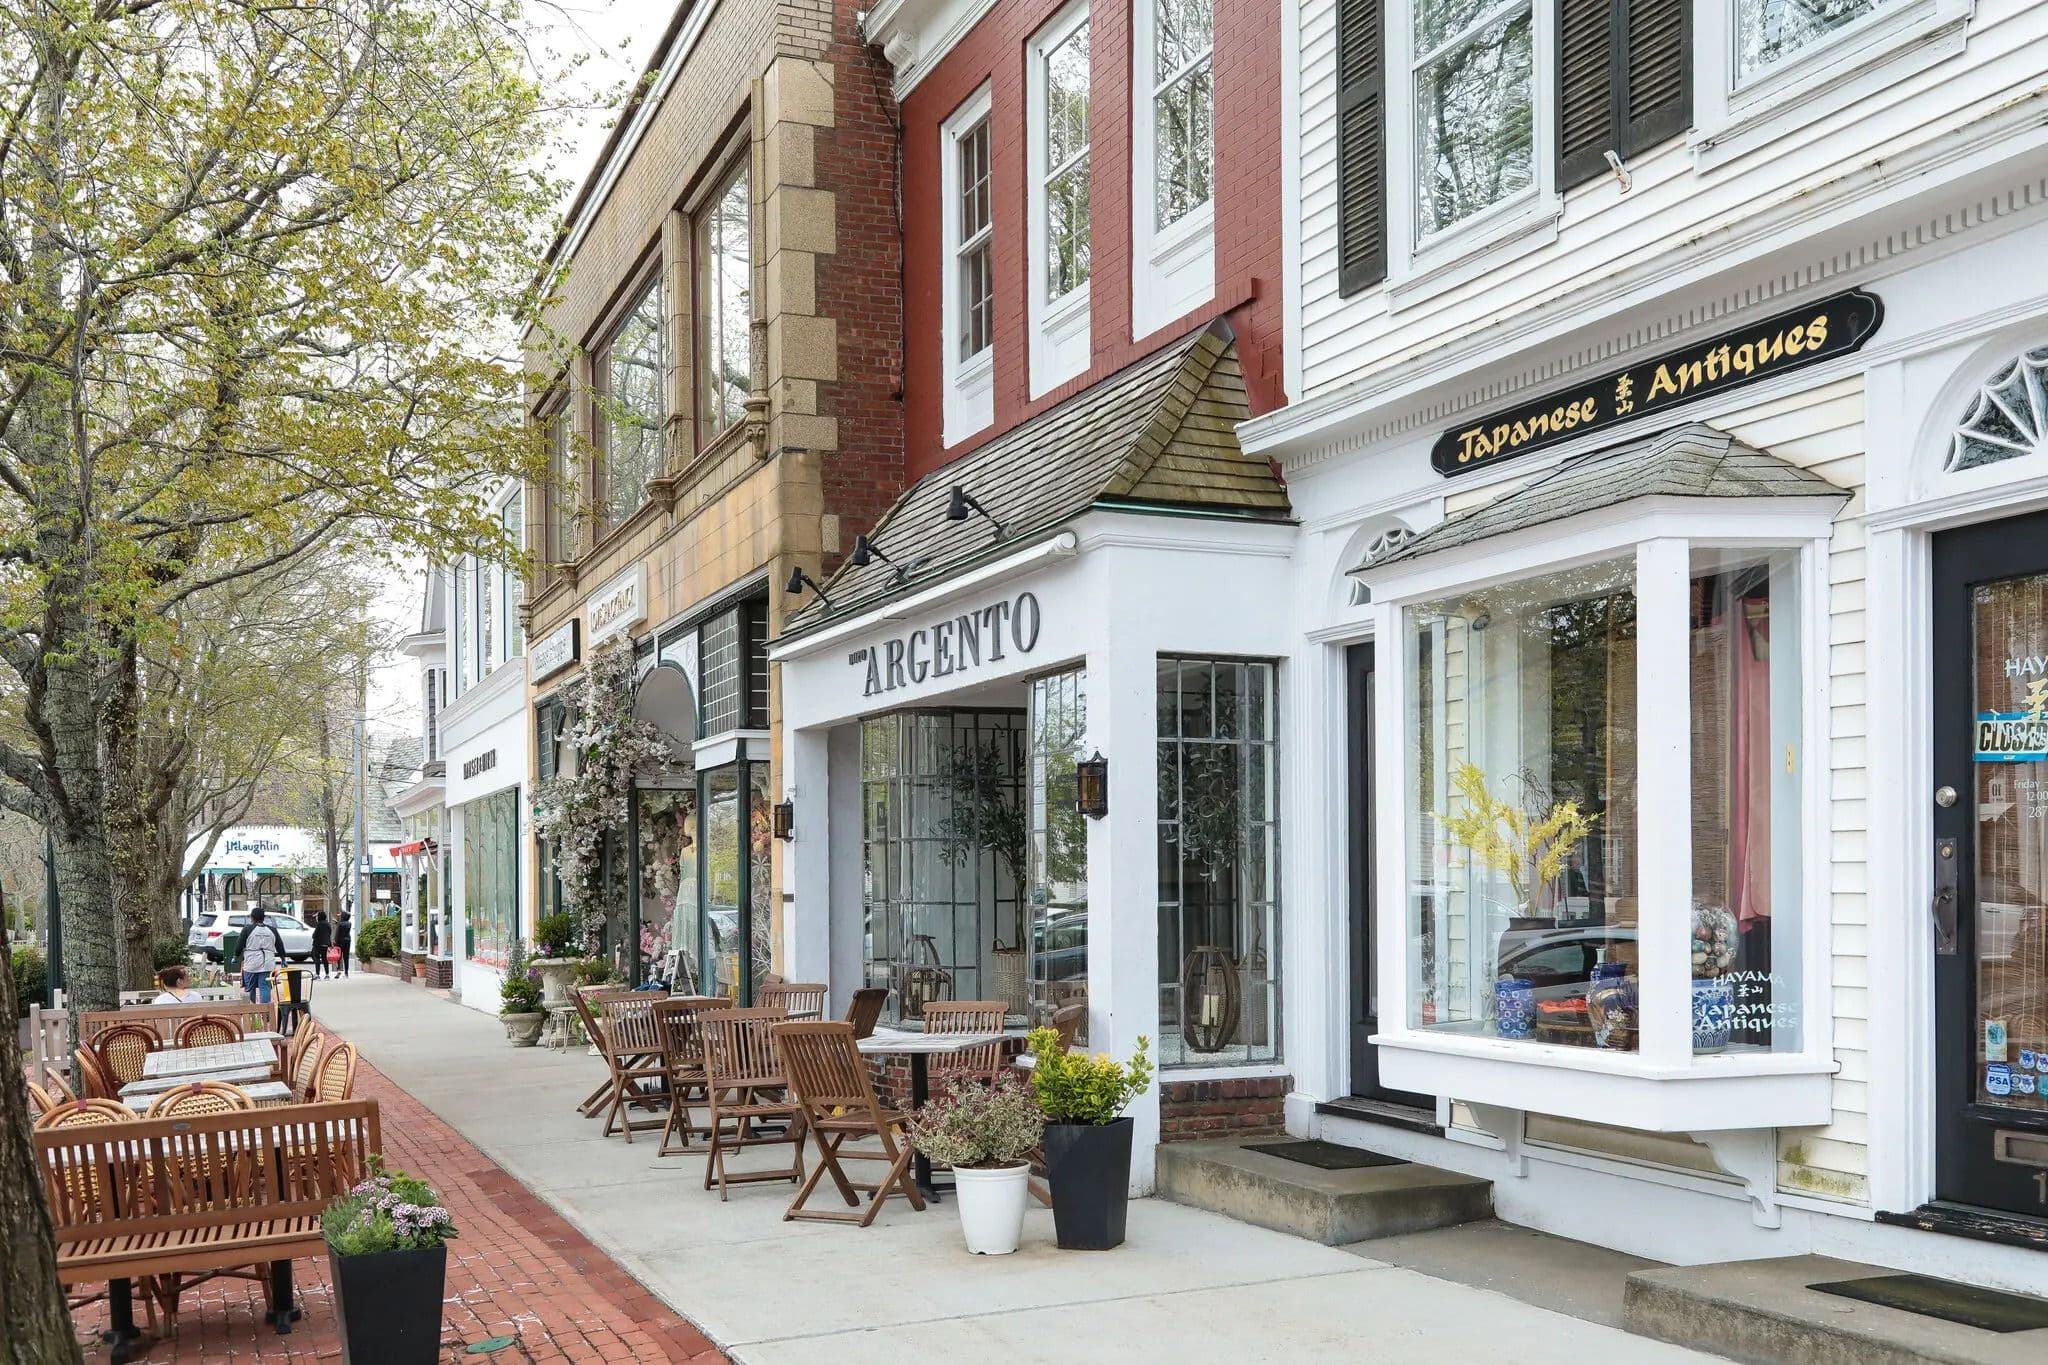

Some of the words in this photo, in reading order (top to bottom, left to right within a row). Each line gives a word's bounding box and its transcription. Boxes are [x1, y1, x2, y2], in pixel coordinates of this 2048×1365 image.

[1457, 396, 1598, 464] Japanese
[1645, 314, 1829, 404] Antiques
[862, 591, 1041, 697] ARGENTO
[1979, 722, 2048, 752] CLOSED
[2013, 779, 2040, 790] Friday
[1712, 970, 1785, 989] HAYAMA
[1696, 1002, 1799, 1017] Japanese
[1699, 1016, 1798, 1032] Antiques
[1989, 1076, 2009, 1086] PSA
